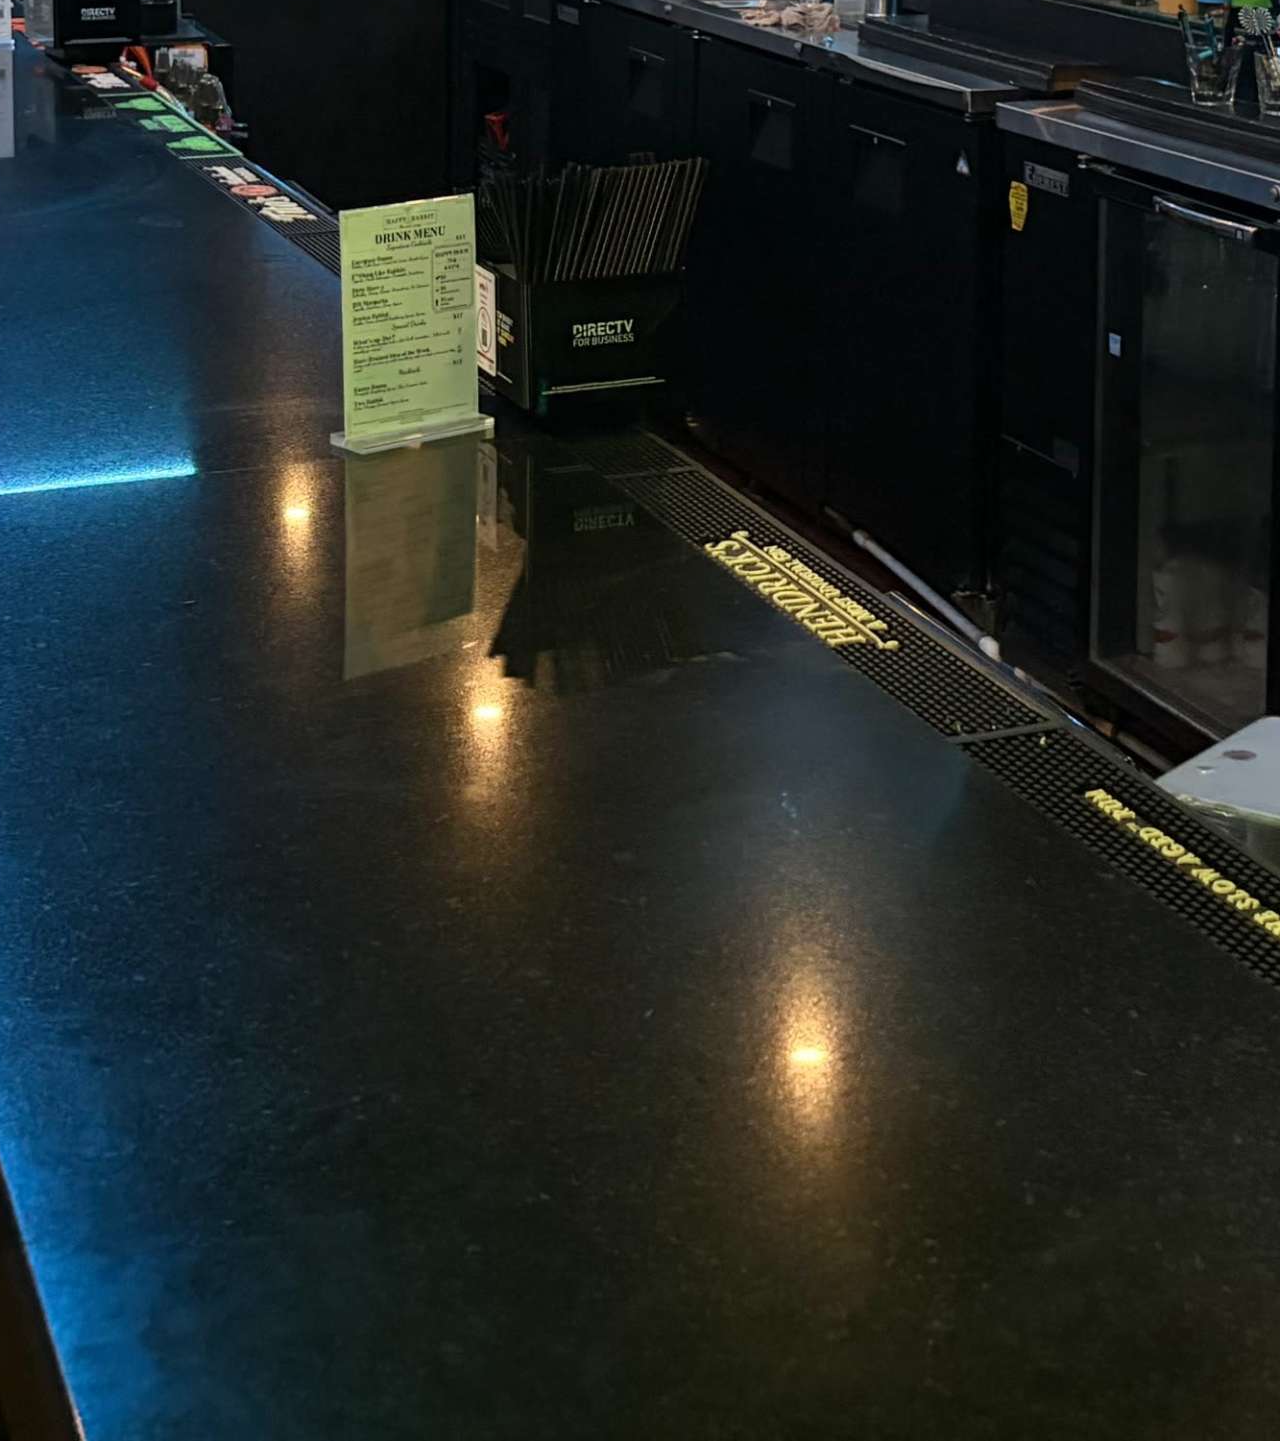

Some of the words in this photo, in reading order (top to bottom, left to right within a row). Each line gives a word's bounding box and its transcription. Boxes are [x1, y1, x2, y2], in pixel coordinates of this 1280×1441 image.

[375, 230, 412, 245] DRINK
[414, 226, 446, 239] MENU
[573, 319, 634, 338] DIRECTV
[573, 336, 590, 348] FOR
[592, 332, 635, 346] BUSINESS
[704, 539, 867, 648] HENDRICK'S
[1084, 788, 1136, 822] RUM
[1191, 865, 1262, 912] SLOW
